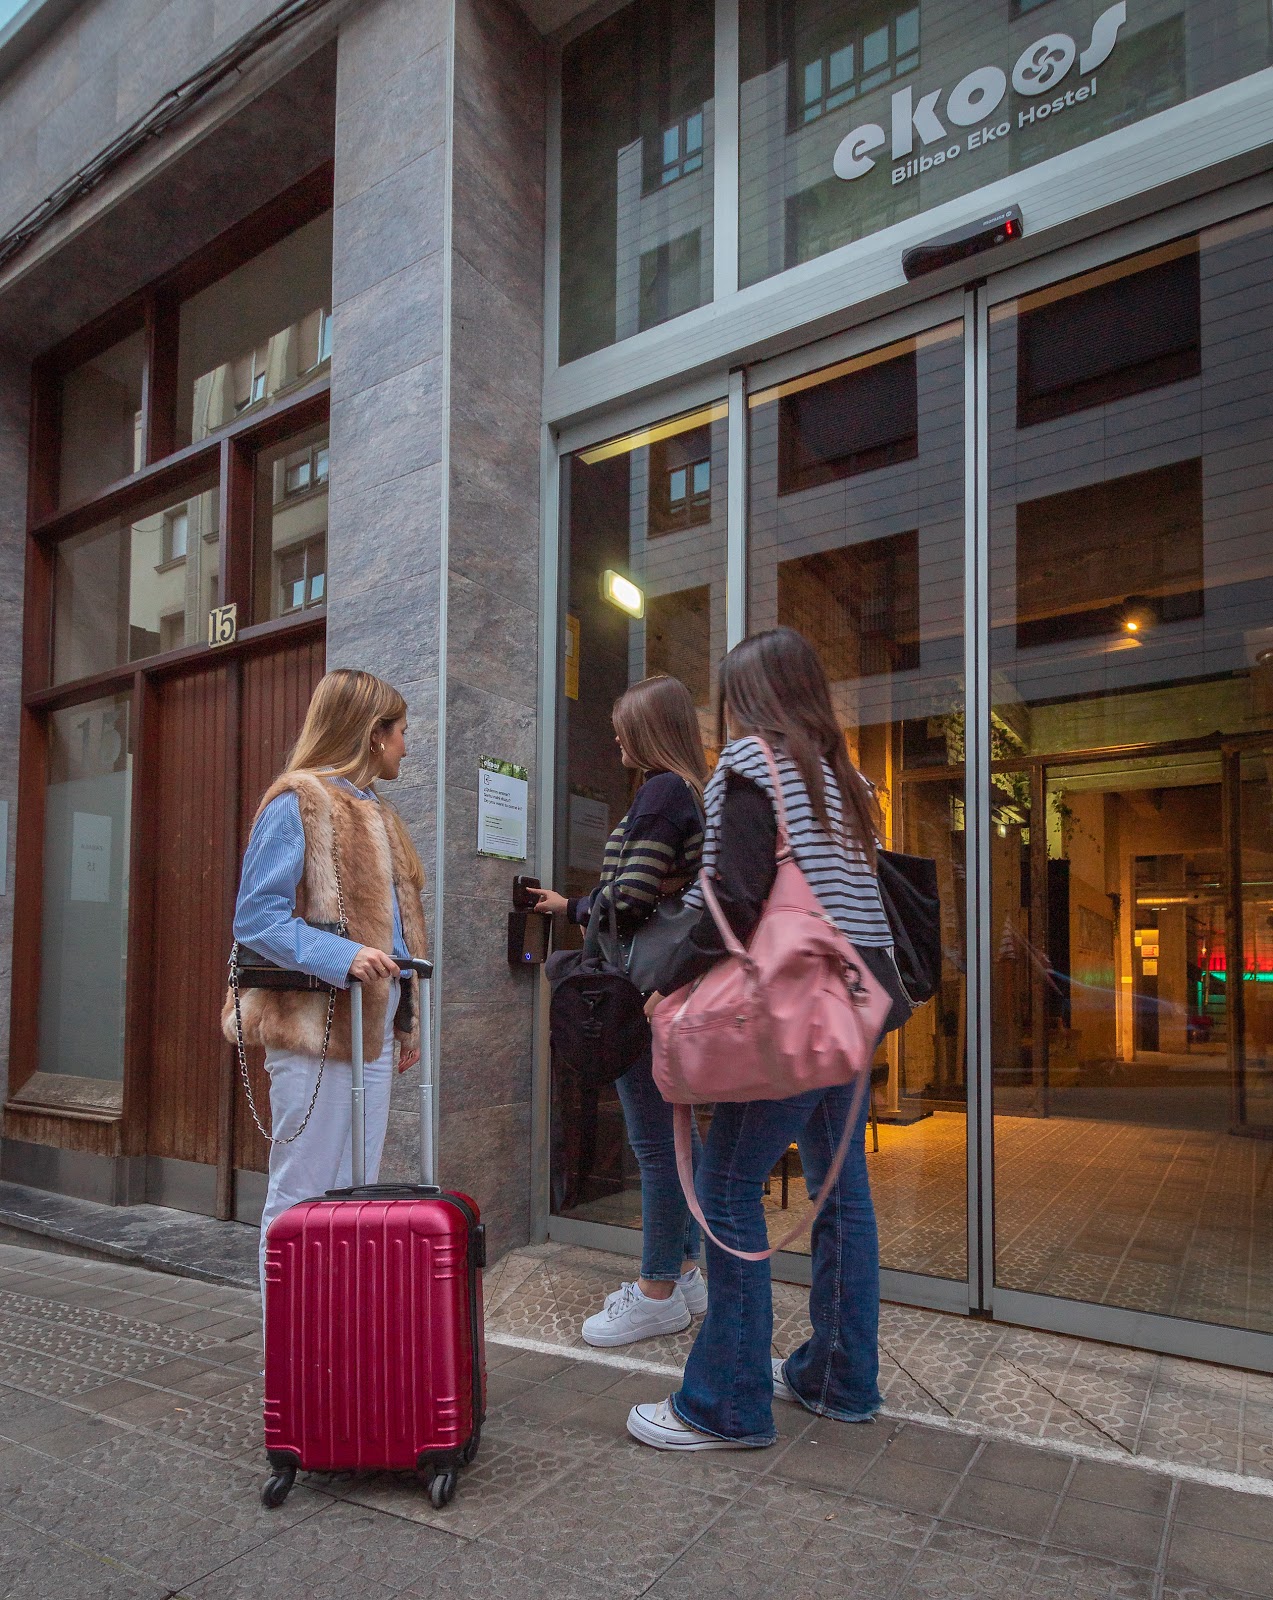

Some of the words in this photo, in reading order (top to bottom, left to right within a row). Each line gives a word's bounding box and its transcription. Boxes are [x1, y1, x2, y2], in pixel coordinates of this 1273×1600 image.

[833, 0, 1127, 180] ekoos
[891, 144, 961, 185] Bilbao
[967, 122, 1011, 151] Eko
[1018, 77, 1097, 128] Hostel
[210, 606, 234, 645] 15
